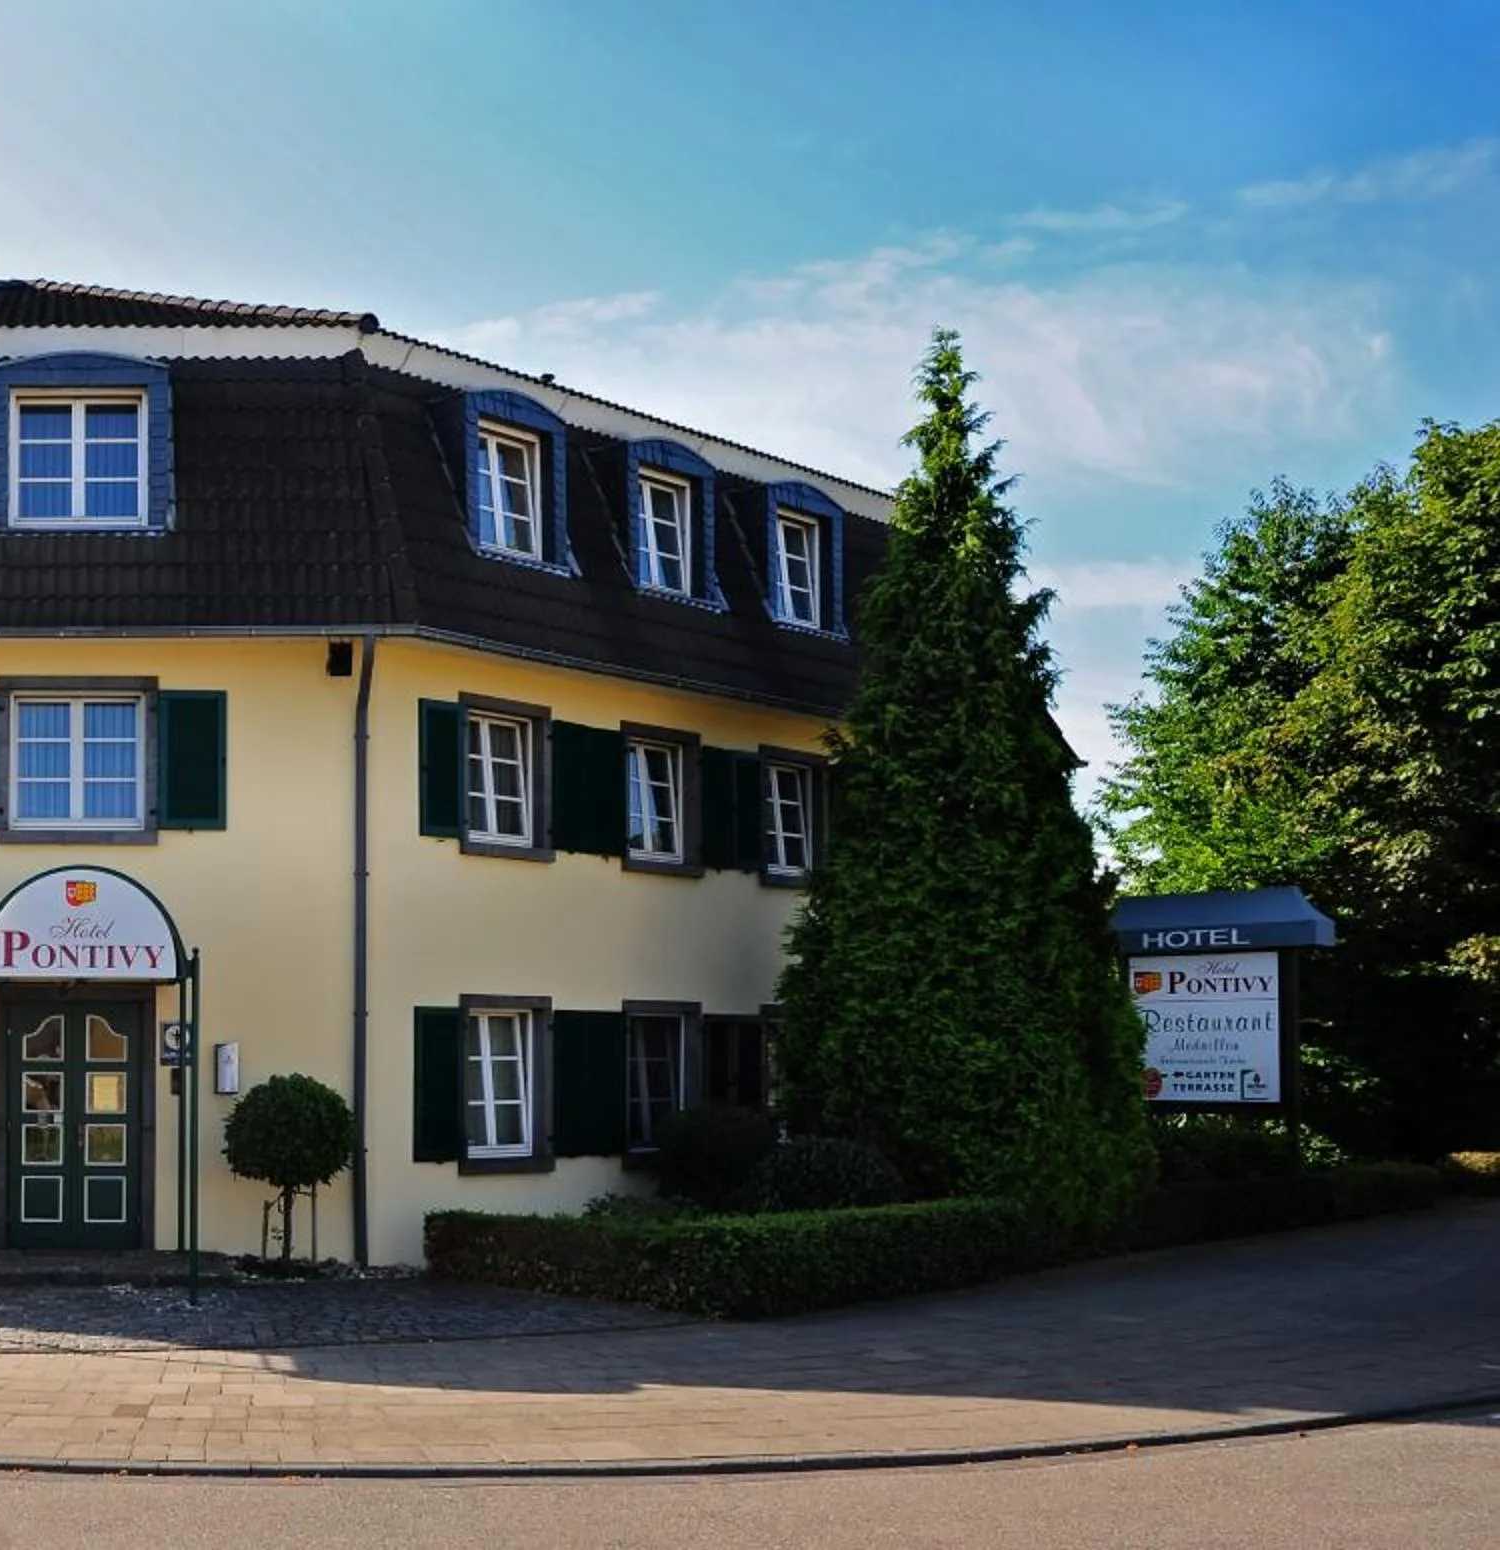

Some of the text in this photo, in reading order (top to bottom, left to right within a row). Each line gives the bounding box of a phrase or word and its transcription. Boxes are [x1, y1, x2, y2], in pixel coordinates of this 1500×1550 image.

[49, 914, 115, 940] Hotel
[0, 930, 165, 969] PONTIVY
[1141, 928, 1250, 949] HOTEL
[1196, 959, 1239, 975] Hotel
[1167, 971, 1274, 994] PONTIVY
[1139, 1008, 1275, 1034] Restaurant
[1185, 1071, 1235, 1080] GARTEN
[1172, 1083, 1235, 1093] TERRASSE
